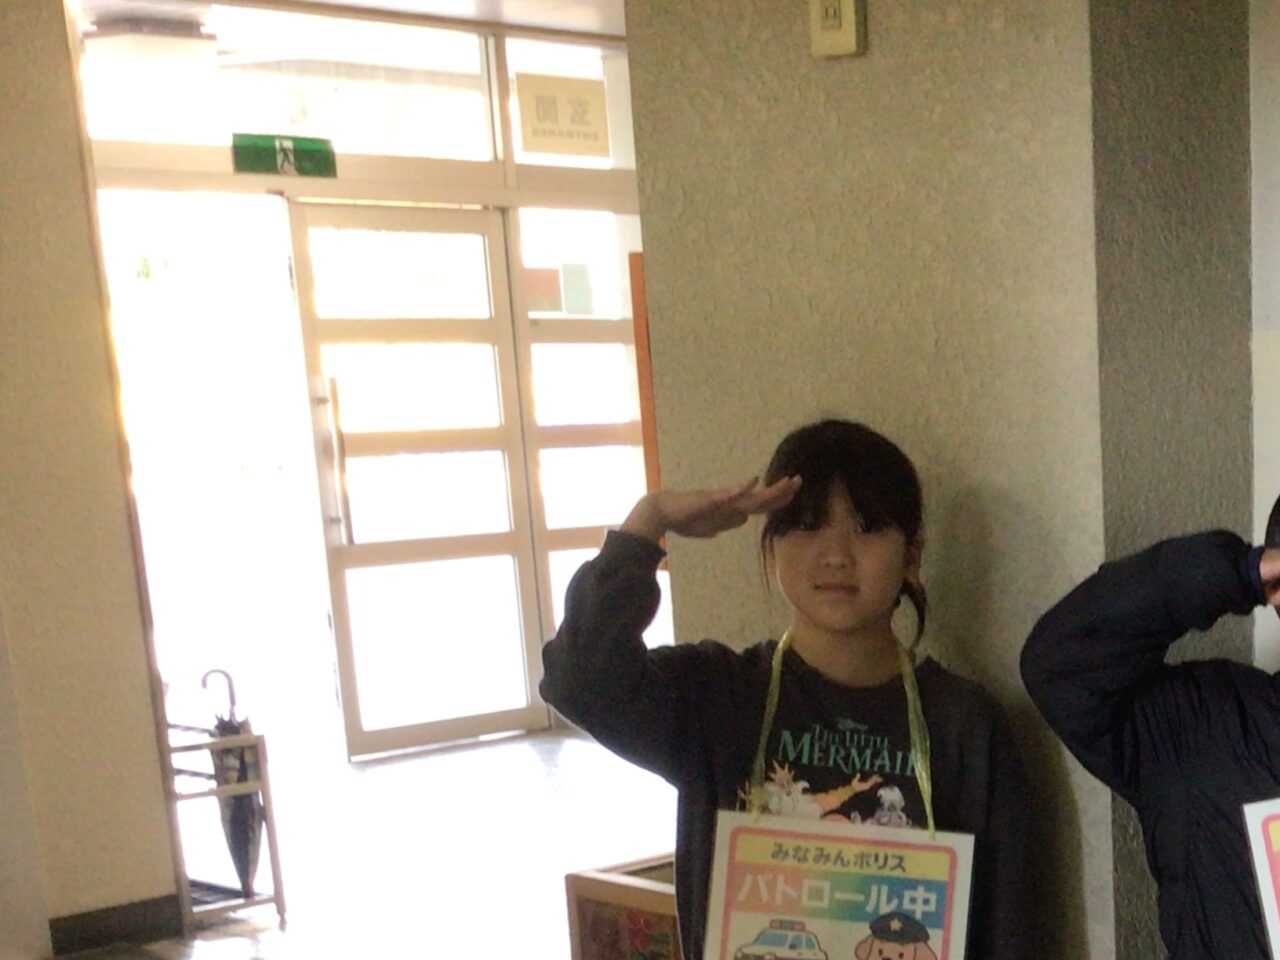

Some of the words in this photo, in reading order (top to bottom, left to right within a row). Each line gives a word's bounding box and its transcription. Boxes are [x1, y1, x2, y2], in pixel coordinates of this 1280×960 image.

[737, 875, 936, 919] パトロール中
